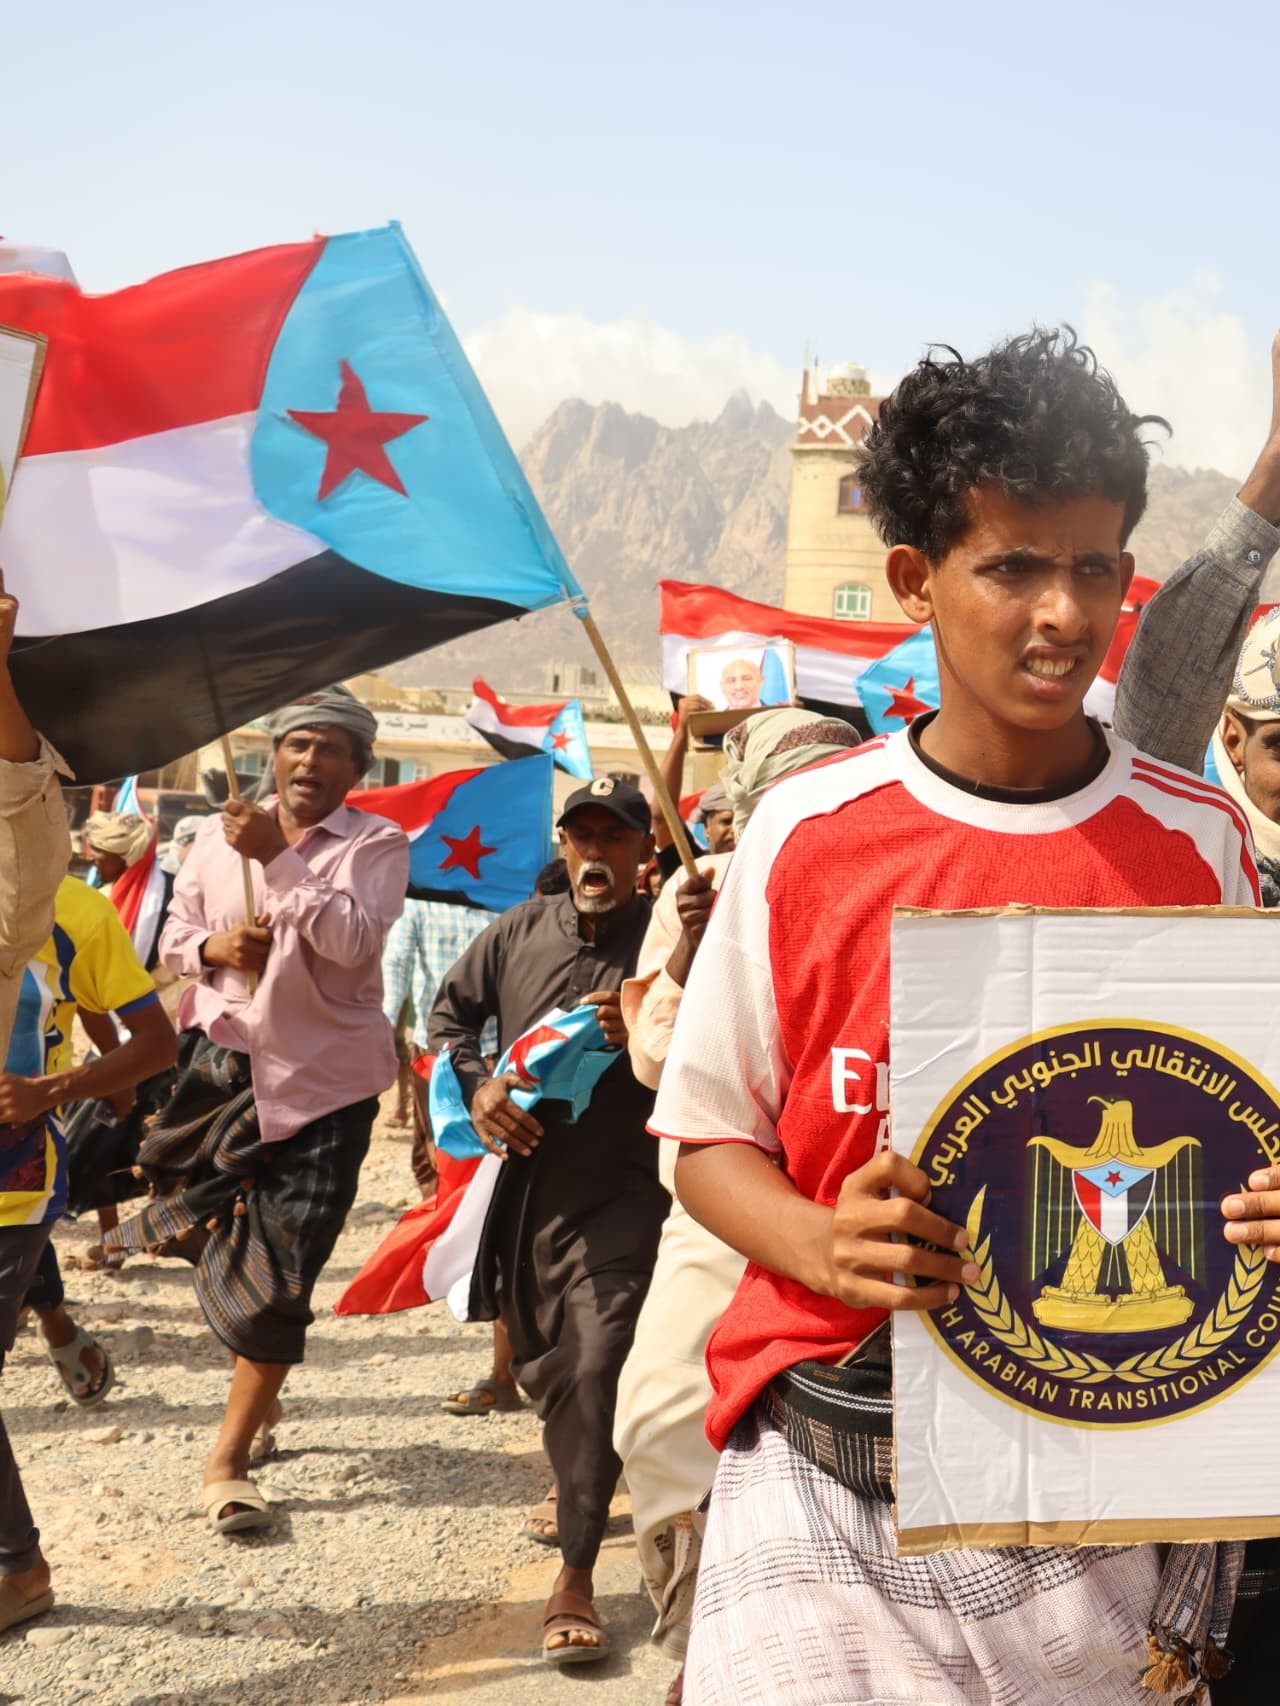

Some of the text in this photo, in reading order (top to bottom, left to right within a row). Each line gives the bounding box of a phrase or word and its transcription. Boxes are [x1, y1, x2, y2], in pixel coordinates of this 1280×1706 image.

[991, 1041, 1101, 1109] الجنوبي
[1110, 1043, 1237, 1102] الانتقالي
[929, 1094, 991, 1187] العربي
[955, 1330, 1059, 1402] ARABIAN
[1068, 1349, 1246, 1411] TRANSITIONAL
